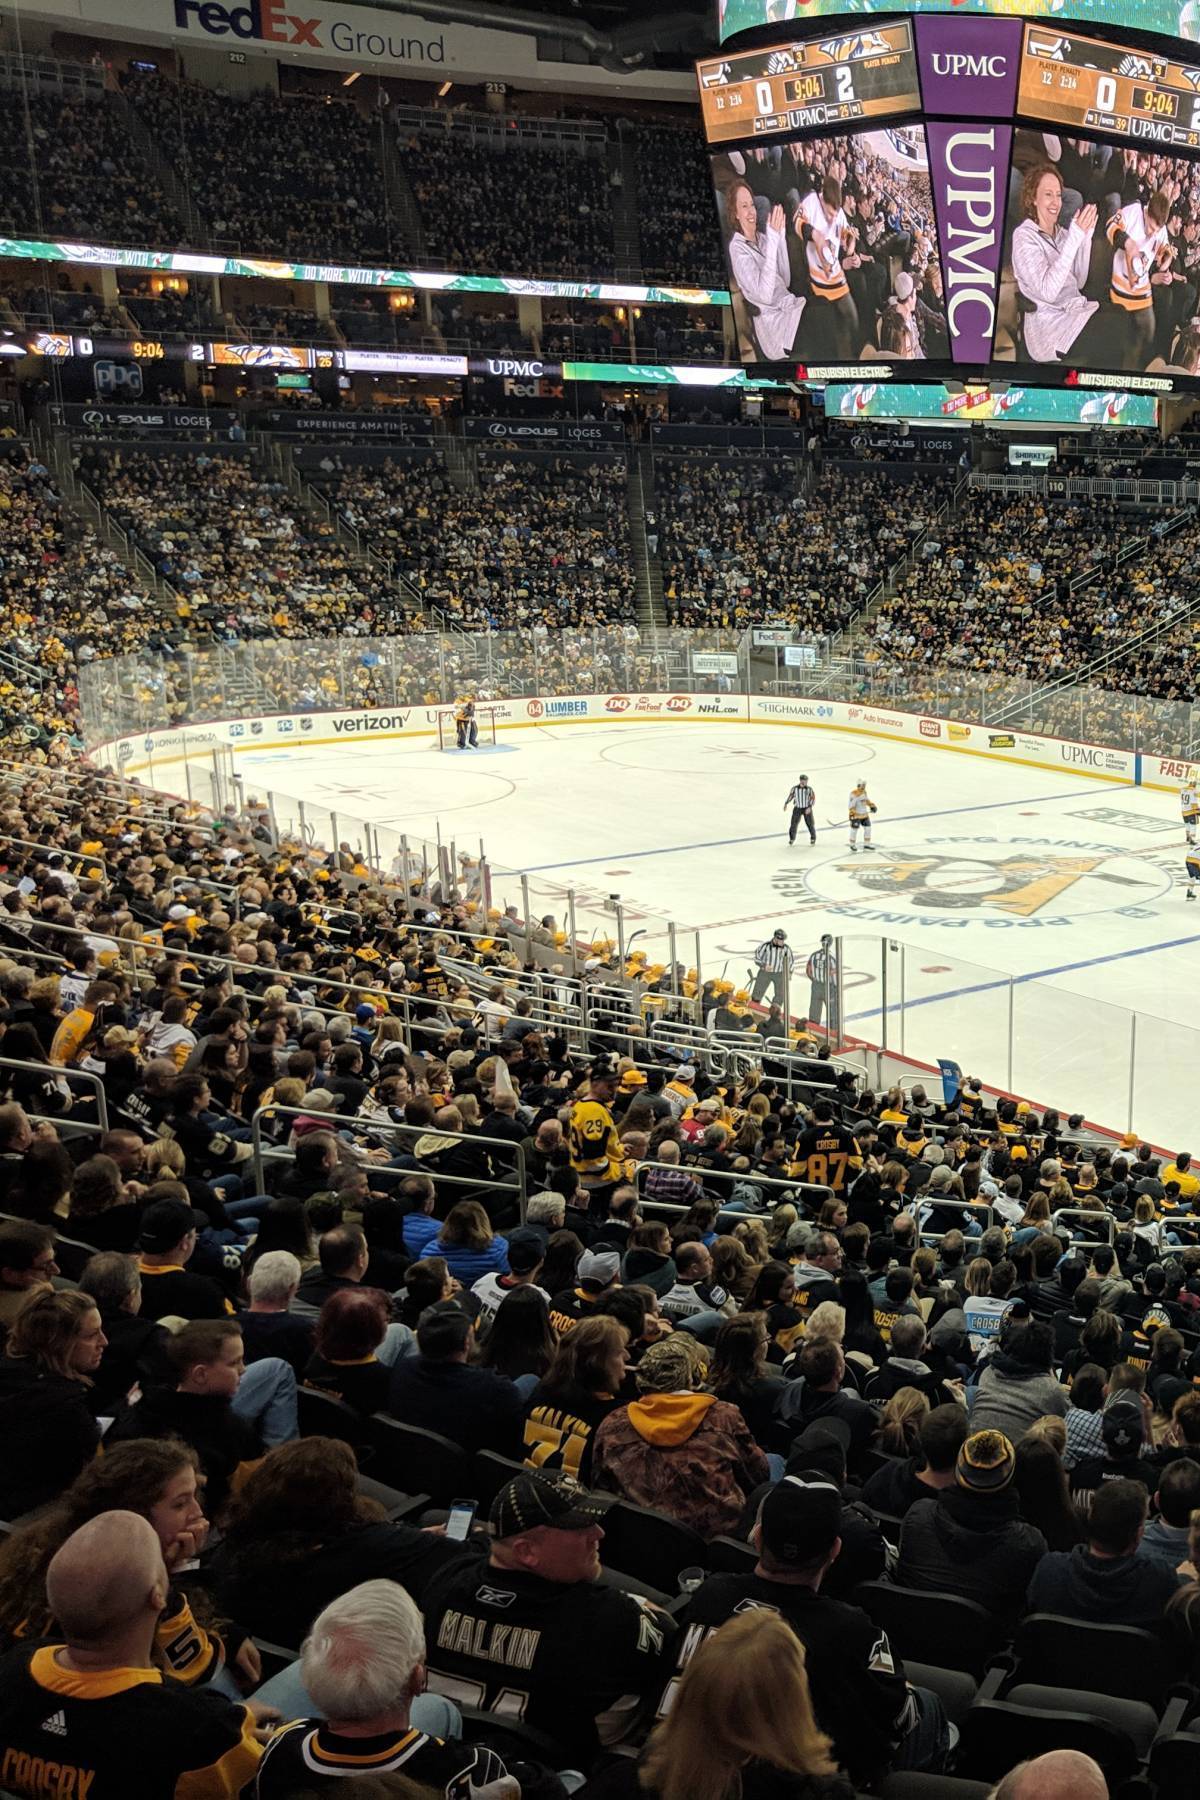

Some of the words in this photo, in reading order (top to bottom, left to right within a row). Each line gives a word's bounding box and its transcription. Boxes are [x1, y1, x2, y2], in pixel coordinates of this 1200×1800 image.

[331, 23, 445, 62] Ground
[229, 53, 246, 63] 212
[796, 51, 803, 62] 3
[931, 54, 1006, 77] UPMC
[1039, 61, 1058, 71] PLAYER
[1060, 65, 1081, 76] PENALTY
[1155, 65, 1162, 75] 3
[486, 82, 506, 93] 213
[836, 66, 855, 102] 2
[1042, 71, 1052, 85] 12
[1060, 75, 1077, 89] 1:14
[794, 78, 821, 100] 9:04
[1096, 77, 1117, 112] 0
[716, 97, 725, 109] 12
[756, 82, 773, 115] 0
[1144, 91, 1173, 114] 9:04
[778, 115, 787, 128] 39
[790, 106, 826, 128] UPMC
[1116, 118, 1127, 131] 39
[1131, 118, 1172, 142] UPMC
[1187, 132, 1198, 144] 25
[945, 128, 996, 338] UPMC
[125, 252, 149, 265] WITH
[304, 265, 316, 279] DO
[319, 266, 345, 281] MORE
[348, 267, 372, 283] WITH
[558, 282, 579, 296] WITH
[80, 339, 94, 354] 0
[133, 342, 165, 358] 9:04
[192, 345, 205, 360] 2
[338, 357, 344, 368] 1
[487, 359, 544, 376] UPMC
[807, 367, 850, 378] MITSUBISHI
[852, 366, 893, 378] ELECTRIC
[503, 378, 564, 398] FedEx
[1080, 373, 1131, 388] MITSUBISHI
[1132, 375, 1174, 392] ELECTRIC
[106, 414, 164, 425] LEXUS
[174, 415, 213, 427] LOGES
[297, 420, 357, 430] EXPERIENCE
[508, 426, 559, 436] LEXUS
[568, 428, 602, 438] LOGES
[869, 439, 915, 448] LEXUS
[923, 440, 953, 450] LOGES
[1050, 482, 1064, 492] 110
[758, 632, 786, 641] FedEx
[529, 702, 542, 716] 84
[545, 701, 588, 714] LUMBER
[608, 698, 629, 710] DQ
[669, 698, 690, 710] DQ
[763, 703, 815, 716] HIGHMARK
[332, 713, 405, 733] verizon
[863, 713, 876, 722] Auto
[877, 716, 904, 727] Insurance
[920, 721, 939, 730] GIANT
[921, 728, 939, 736] EAGLE
[1061, 745, 1104, 767] UPMC
[1160, 760, 1192, 779] FAST
[925, 835, 999, 845] PPG
[1009, 836, 1129, 853] PAINTS
[771, 866, 818, 905] ARENA
[825, 906, 965, 928] PAINTS
[977, 915, 1073, 928] PPG
[585, 1118, 603, 1134] 29
[815, 1138, 840, 1150] CROSBY
[807, 1153, 849, 1191] 87
[971, 1316, 1001, 1330] CROSB
[530, 1405, 592, 1438] MALKIN
[523, 1418, 588, 1480] 71
[437, 1609, 542, 1671] MALKIN
[164, 1626, 202, 1672] 5
[0, 1748, 96, 1800] CROSBY
